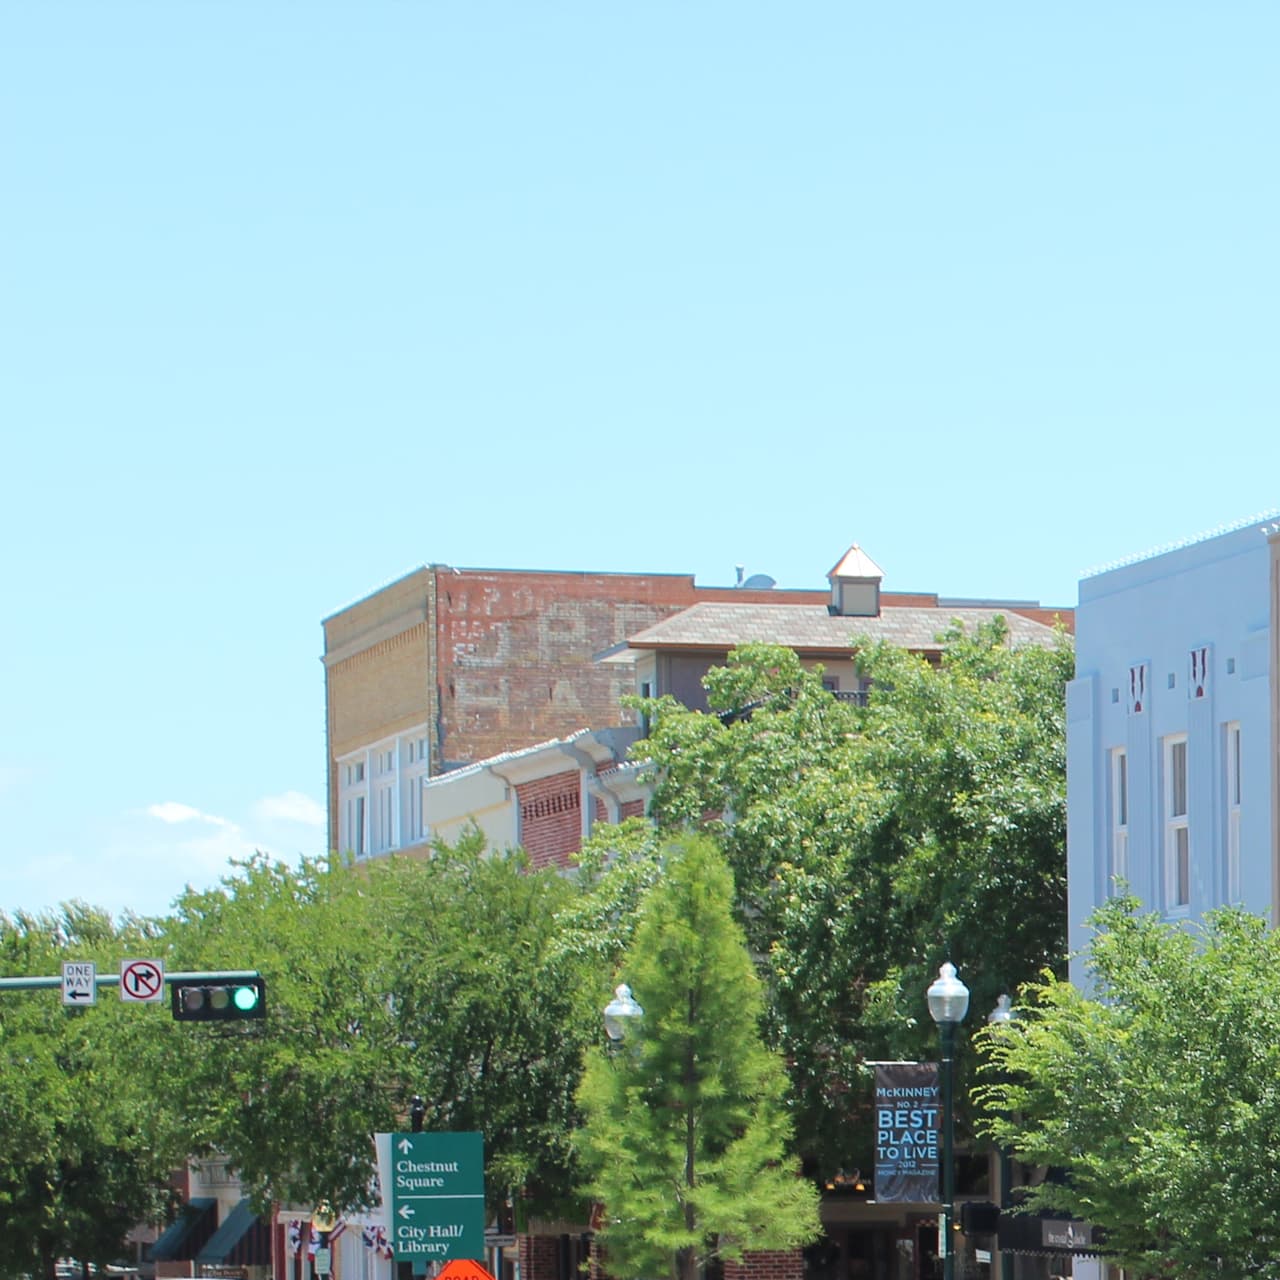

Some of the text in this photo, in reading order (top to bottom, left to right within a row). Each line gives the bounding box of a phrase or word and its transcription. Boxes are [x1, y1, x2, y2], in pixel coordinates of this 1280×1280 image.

[66, 965, 90, 976] ONE
[66, 978, 90, 988] WAY
[876, 1087, 939, 1097] McKINNEY
[878, 1110, 937, 1128] BEST
[878, 1130, 937, 1144] PLACE
[877, 1147, 937, 1159] TO LIVE
[397, 1160, 458, 1173] Chestnut
[397, 1176, 444, 1190] Square
[398, 1225, 463, 1240] City Hall/
[398, 1241, 449, 1254] Library
